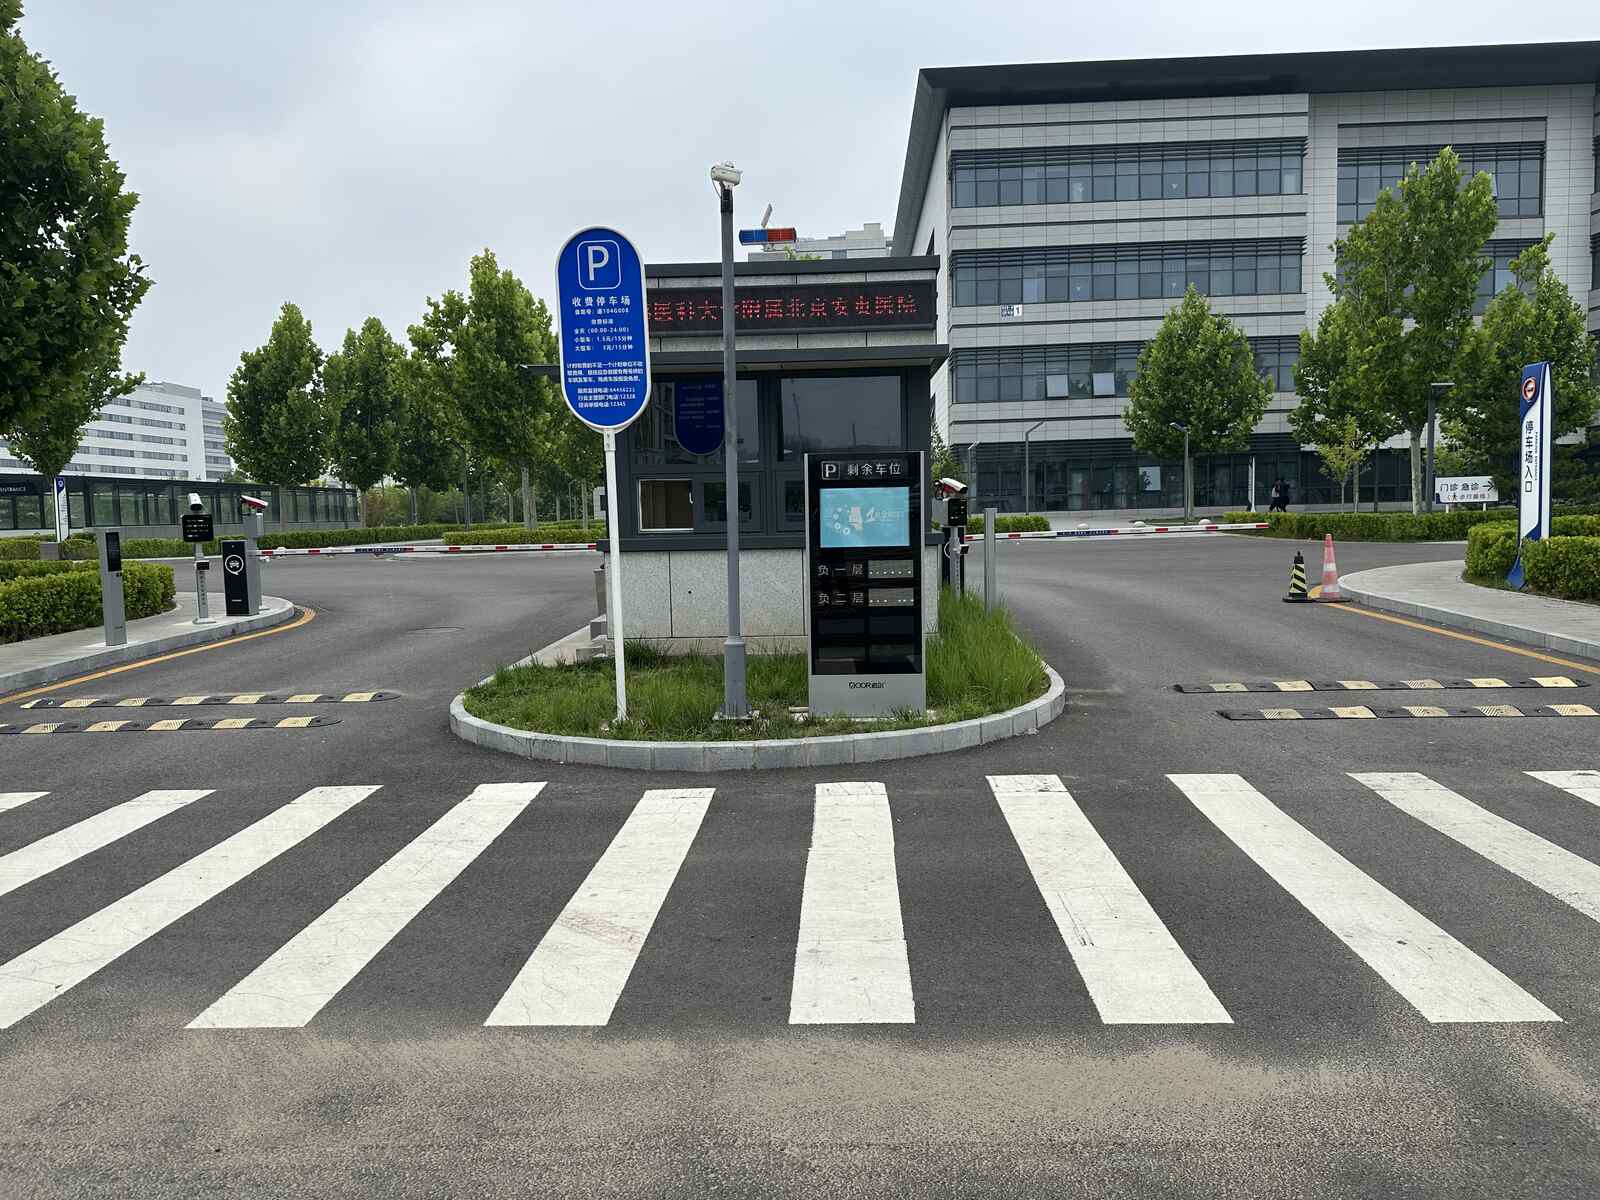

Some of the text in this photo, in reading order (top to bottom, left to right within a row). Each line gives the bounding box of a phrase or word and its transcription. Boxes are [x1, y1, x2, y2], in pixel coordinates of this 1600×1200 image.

[587, 246, 609, 281] P
[572, 295, 631, 307] 收费停车场
[1524, 420, 1534, 493] 停车场入口
[825, 463, 837, 478] P
[847, 462, 902, 477] 剩余车位
[818, 563, 863, 576] 负一层
[818, 592, 864, 604] 负二层
